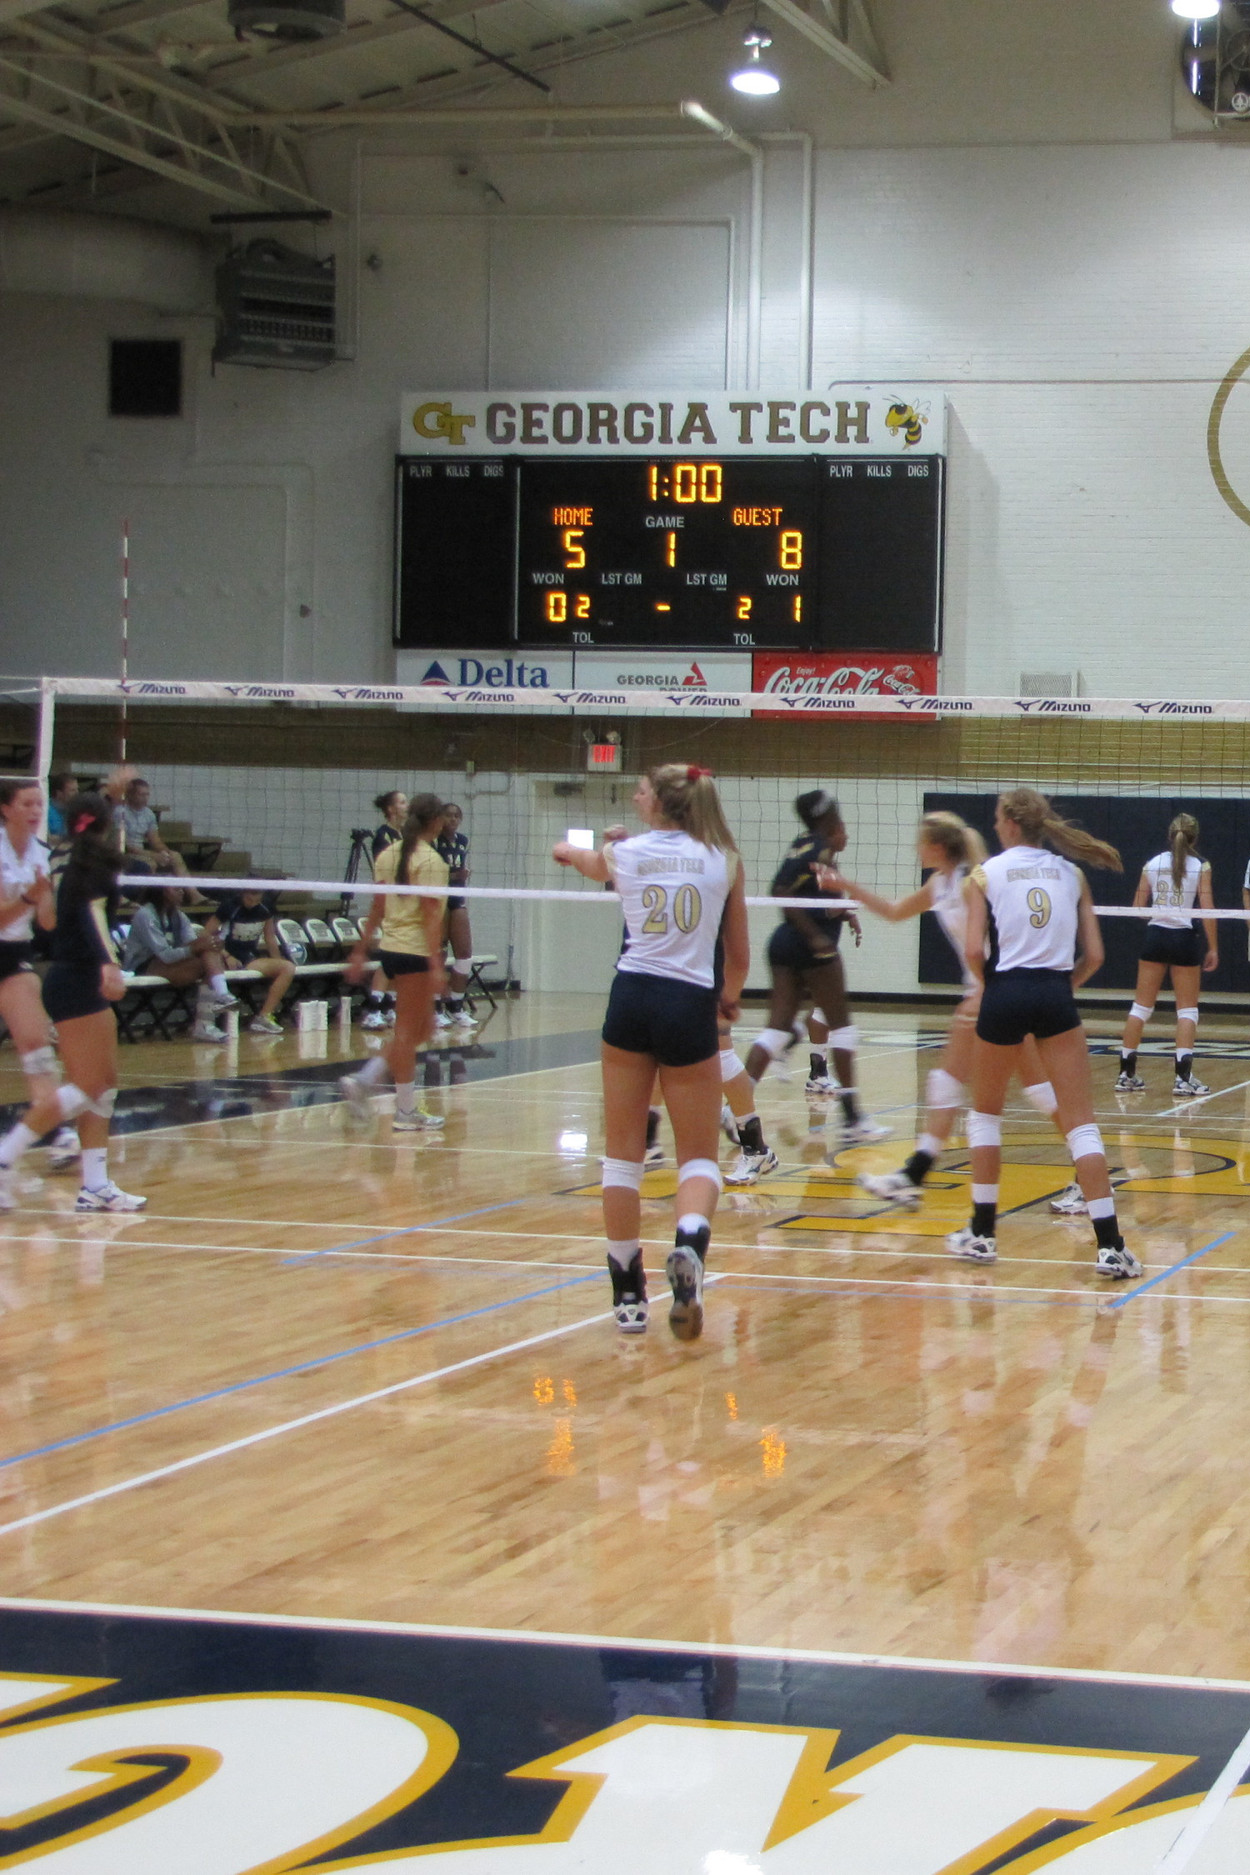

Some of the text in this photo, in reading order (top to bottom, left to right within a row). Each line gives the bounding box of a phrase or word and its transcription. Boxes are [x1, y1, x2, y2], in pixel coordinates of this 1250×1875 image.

[412, 402, 476, 445] GT
[486, 401, 870, 444] GEORGIA TECH
[409, 465, 504, 477] PLYR KILLS DIGS
[829, 465, 929, 477] PLYR KILLS DIGS
[648, 463, 722, 503] 1:00
[554, 507, 593, 526] HOME
[645, 516, 685, 528] GAME
[732, 507, 783, 526] GUEST
[564, 530, 586, 569] 5
[666, 531, 676, 568] 1
[780, 530, 802, 569] 8
[532, 573, 565, 585] WON
[601, 573, 643, 586] LST GM
[686, 573, 727, 586] LST GM
[766, 574, 799, 586] WON
[577, 596, 591, 619] 2
[737, 596, 752, 619] 2
[572, 632, 595, 644] TOL
[733, 633, 756, 645] TOL
[457, 658, 550, 688] Delta
[617, 675, 679, 685] GEORGIA
[642, 883, 702, 934] 20
[1027, 887, 1052, 928] 9
